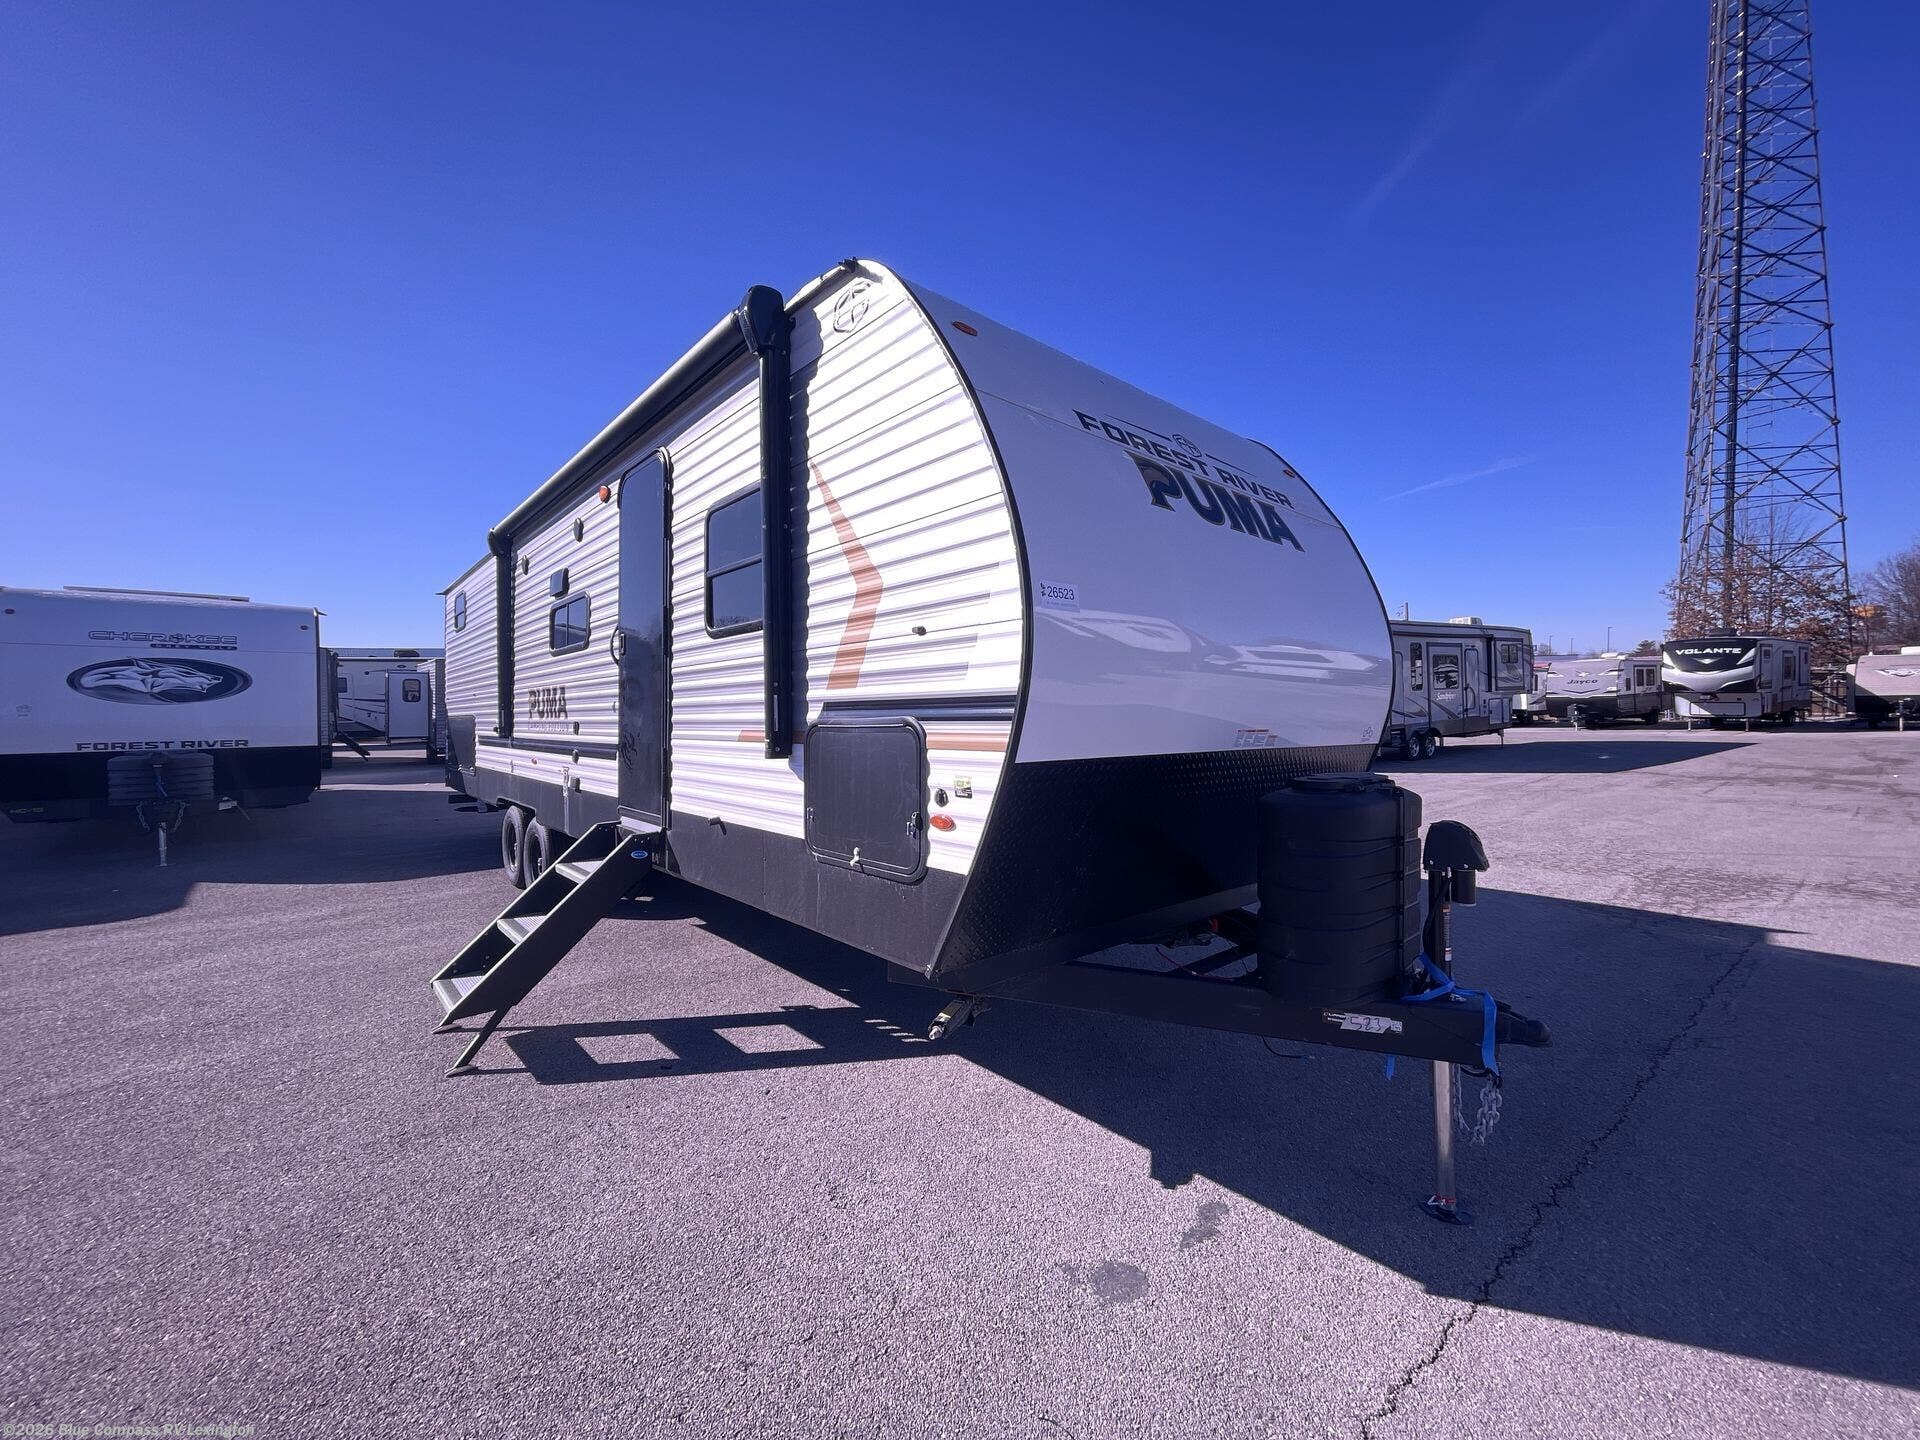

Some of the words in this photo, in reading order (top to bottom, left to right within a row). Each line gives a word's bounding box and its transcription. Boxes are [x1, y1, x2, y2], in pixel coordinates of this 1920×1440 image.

[1071, 408, 1209, 477] FOREST
[1213, 466, 1295, 510] RIVER
[1123, 449, 1305, 553] PUMA
[1046, 585, 1075, 601] 26523
[88, 630, 238, 645] CHEROKEE
[1675, 647, 1742, 655] VOLANTE
[528, 685, 568, 719] PUMA
[76, 740, 175, 751] FOREST
[180, 739, 249, 749] RIVER
[1350, 1016, 1382, 1031] 523
